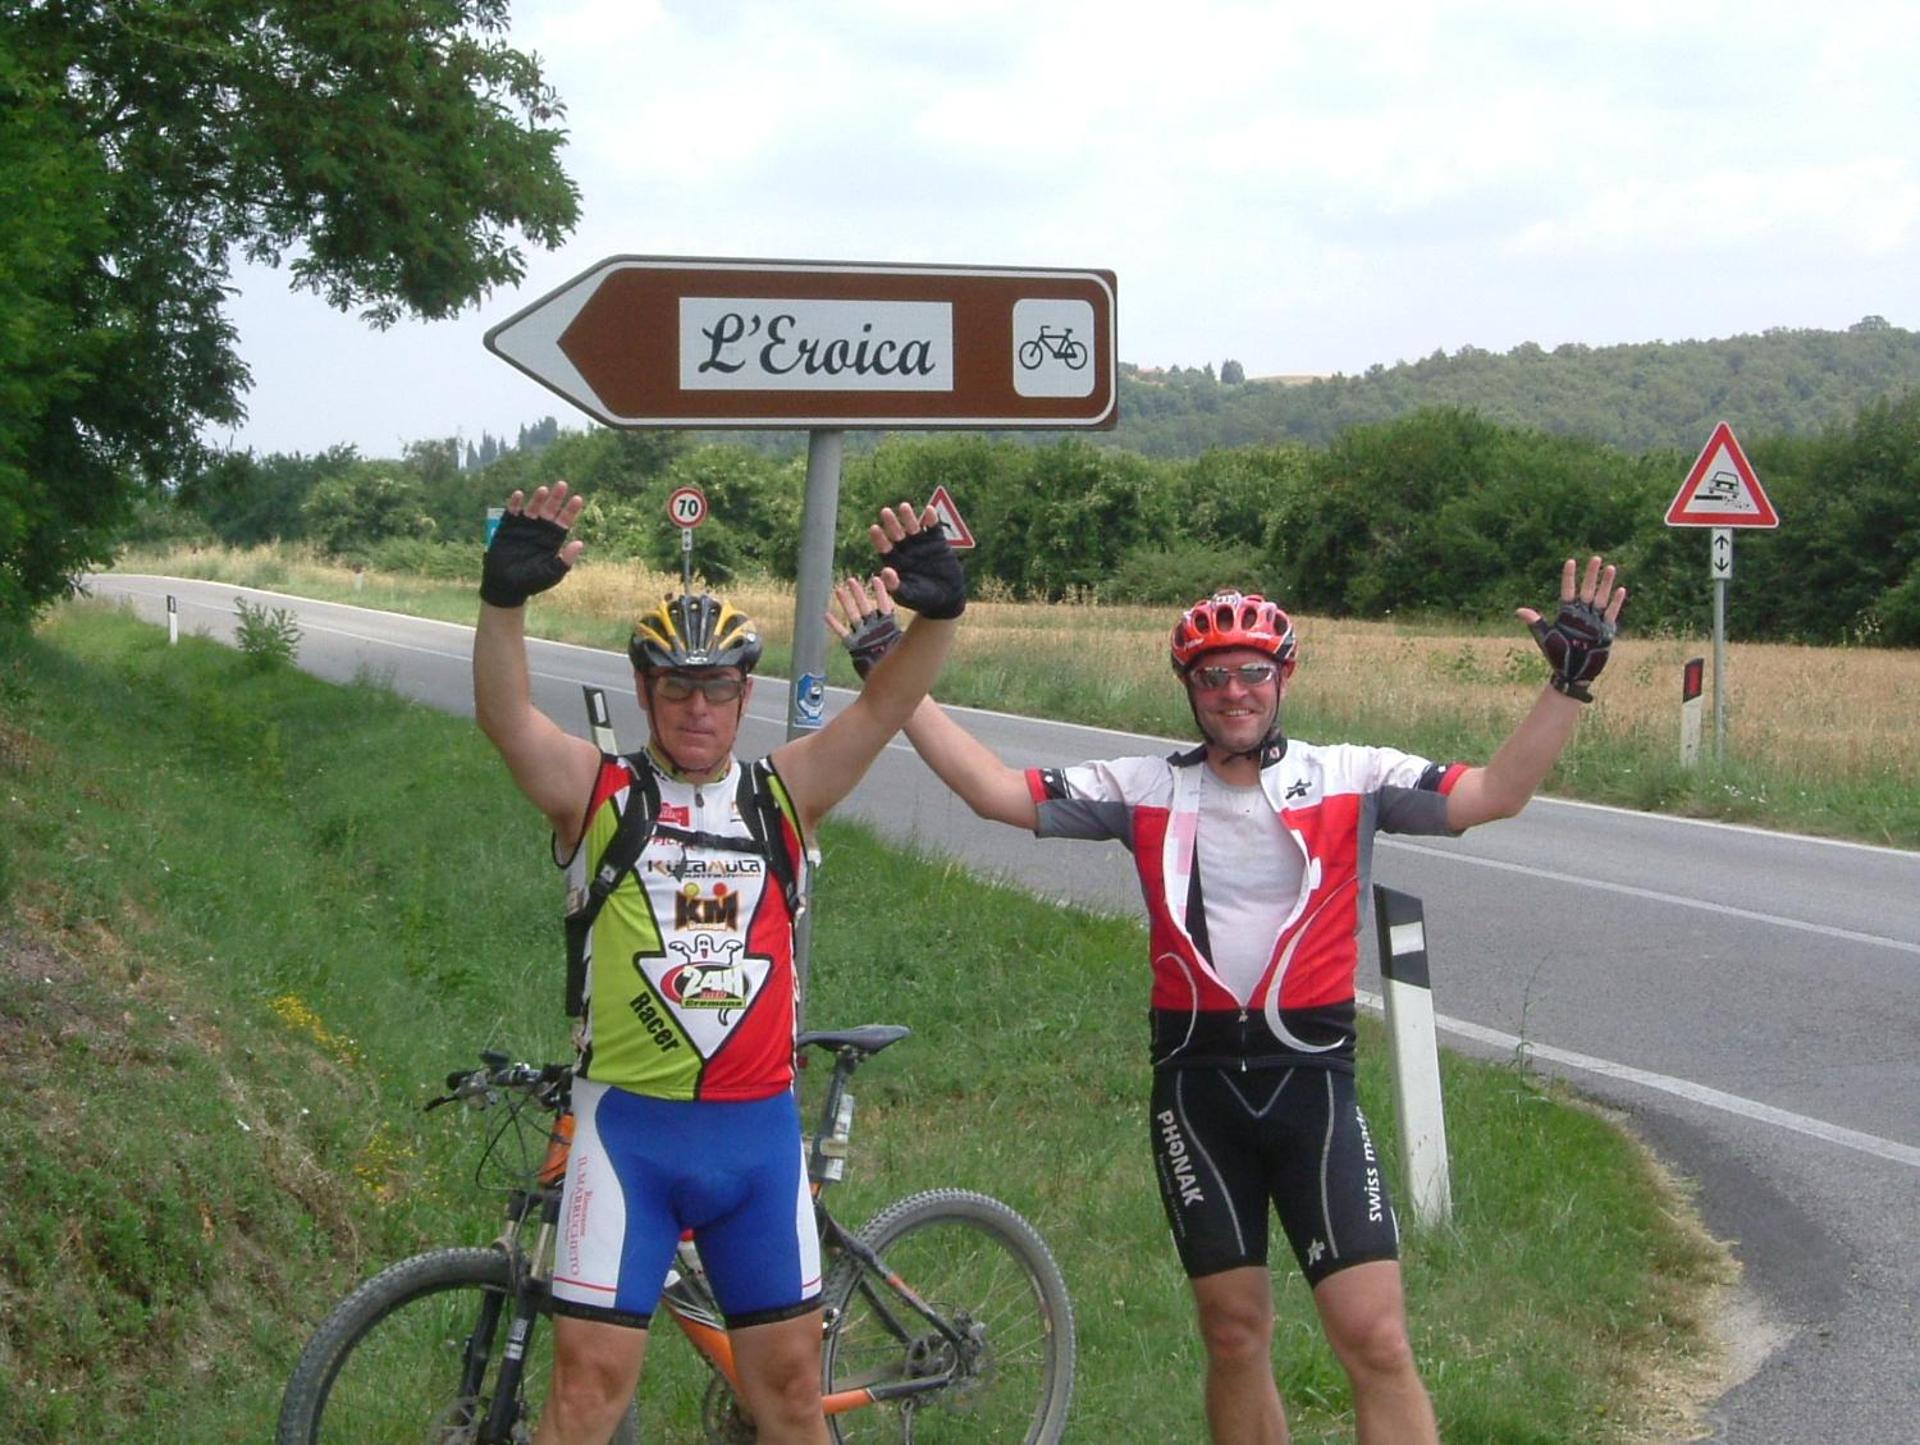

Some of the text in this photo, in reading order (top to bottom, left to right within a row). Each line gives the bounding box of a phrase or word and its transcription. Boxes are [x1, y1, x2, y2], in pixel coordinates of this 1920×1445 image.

[698, 313, 936, 376] L'Eroica
[678, 499, 699, 517] 70
[629, 991, 680, 1052] Racer
[1157, 1109, 1205, 1206] PHONAK
[1363, 1166, 1383, 1222] swiss
